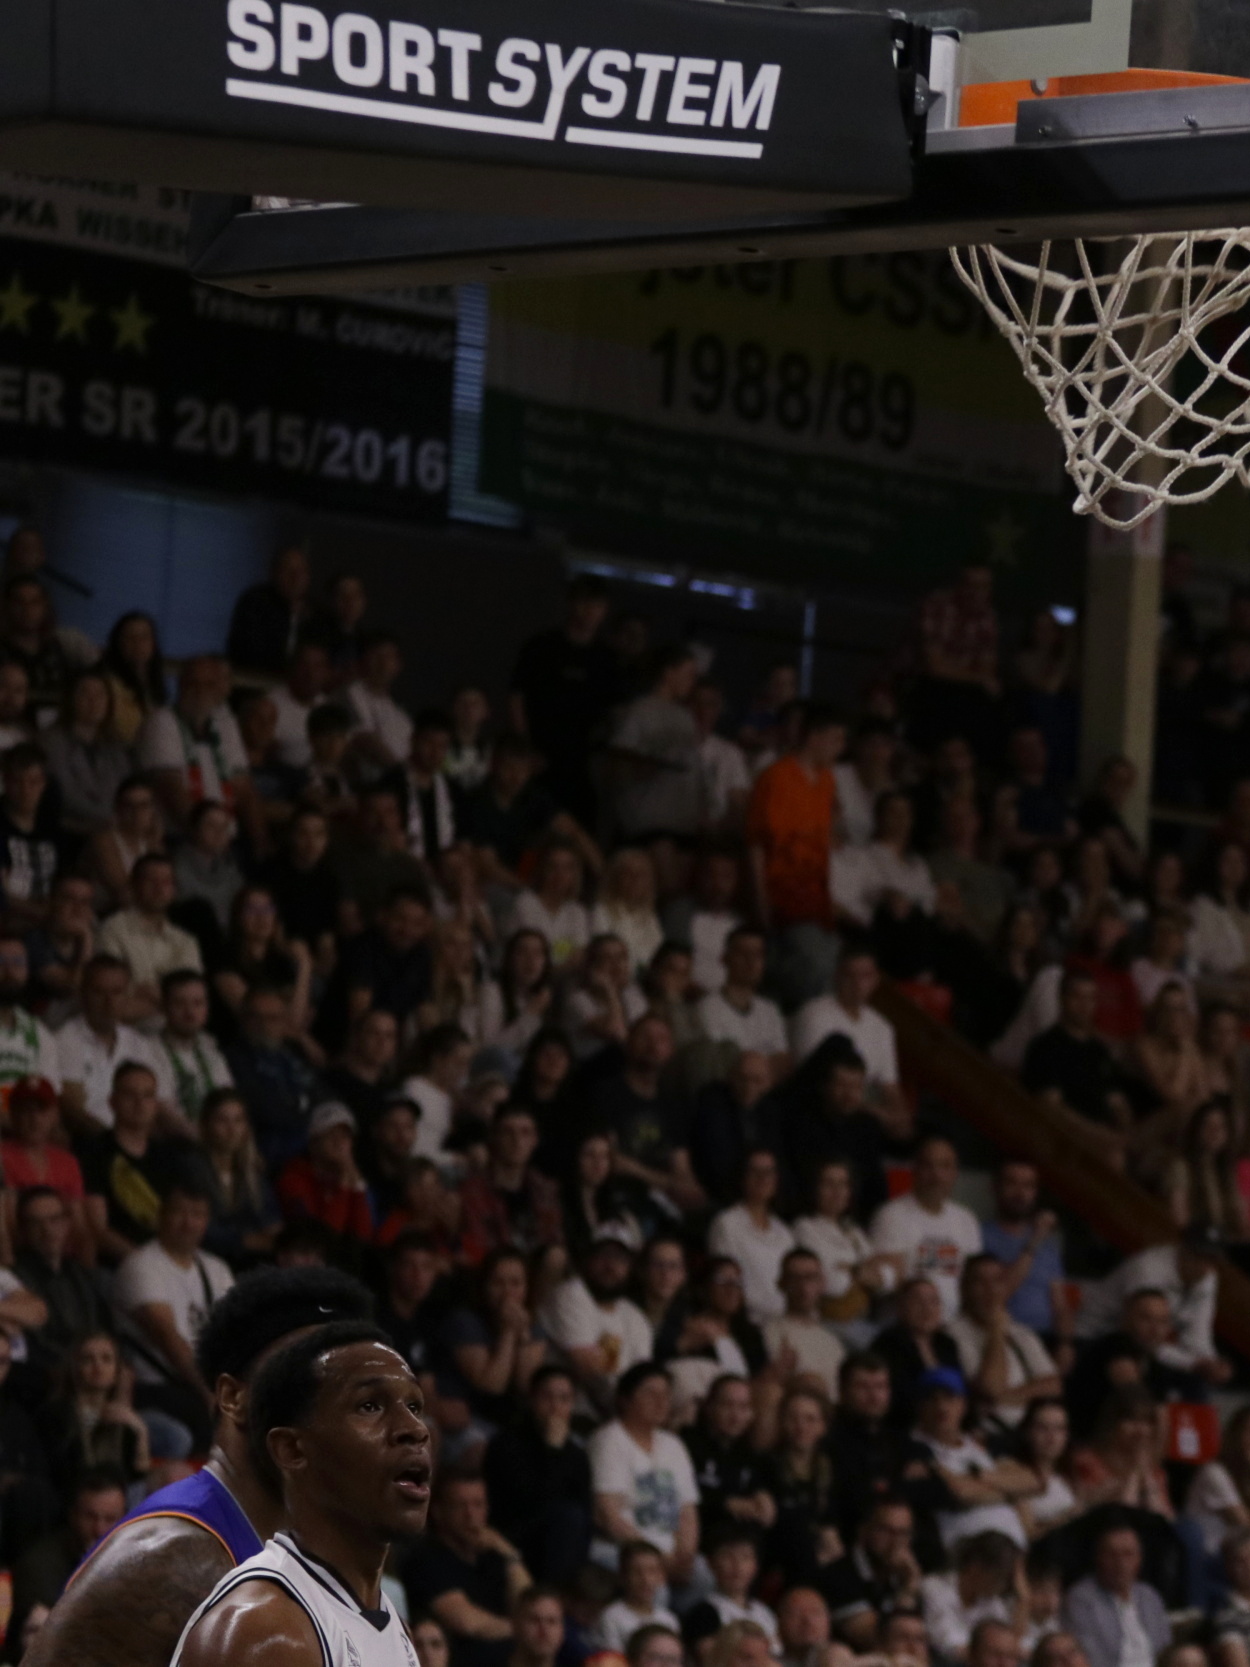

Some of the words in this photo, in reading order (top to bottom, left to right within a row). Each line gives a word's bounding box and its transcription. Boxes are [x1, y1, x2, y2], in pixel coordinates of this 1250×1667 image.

[226, 0, 482, 101] SPORT
[488, 38, 781, 138] SYSTEM
[80, 379, 158, 445] SR
[172, 394, 449, 494] 2015/2016
[650, 324, 914, 450] 1988/89
